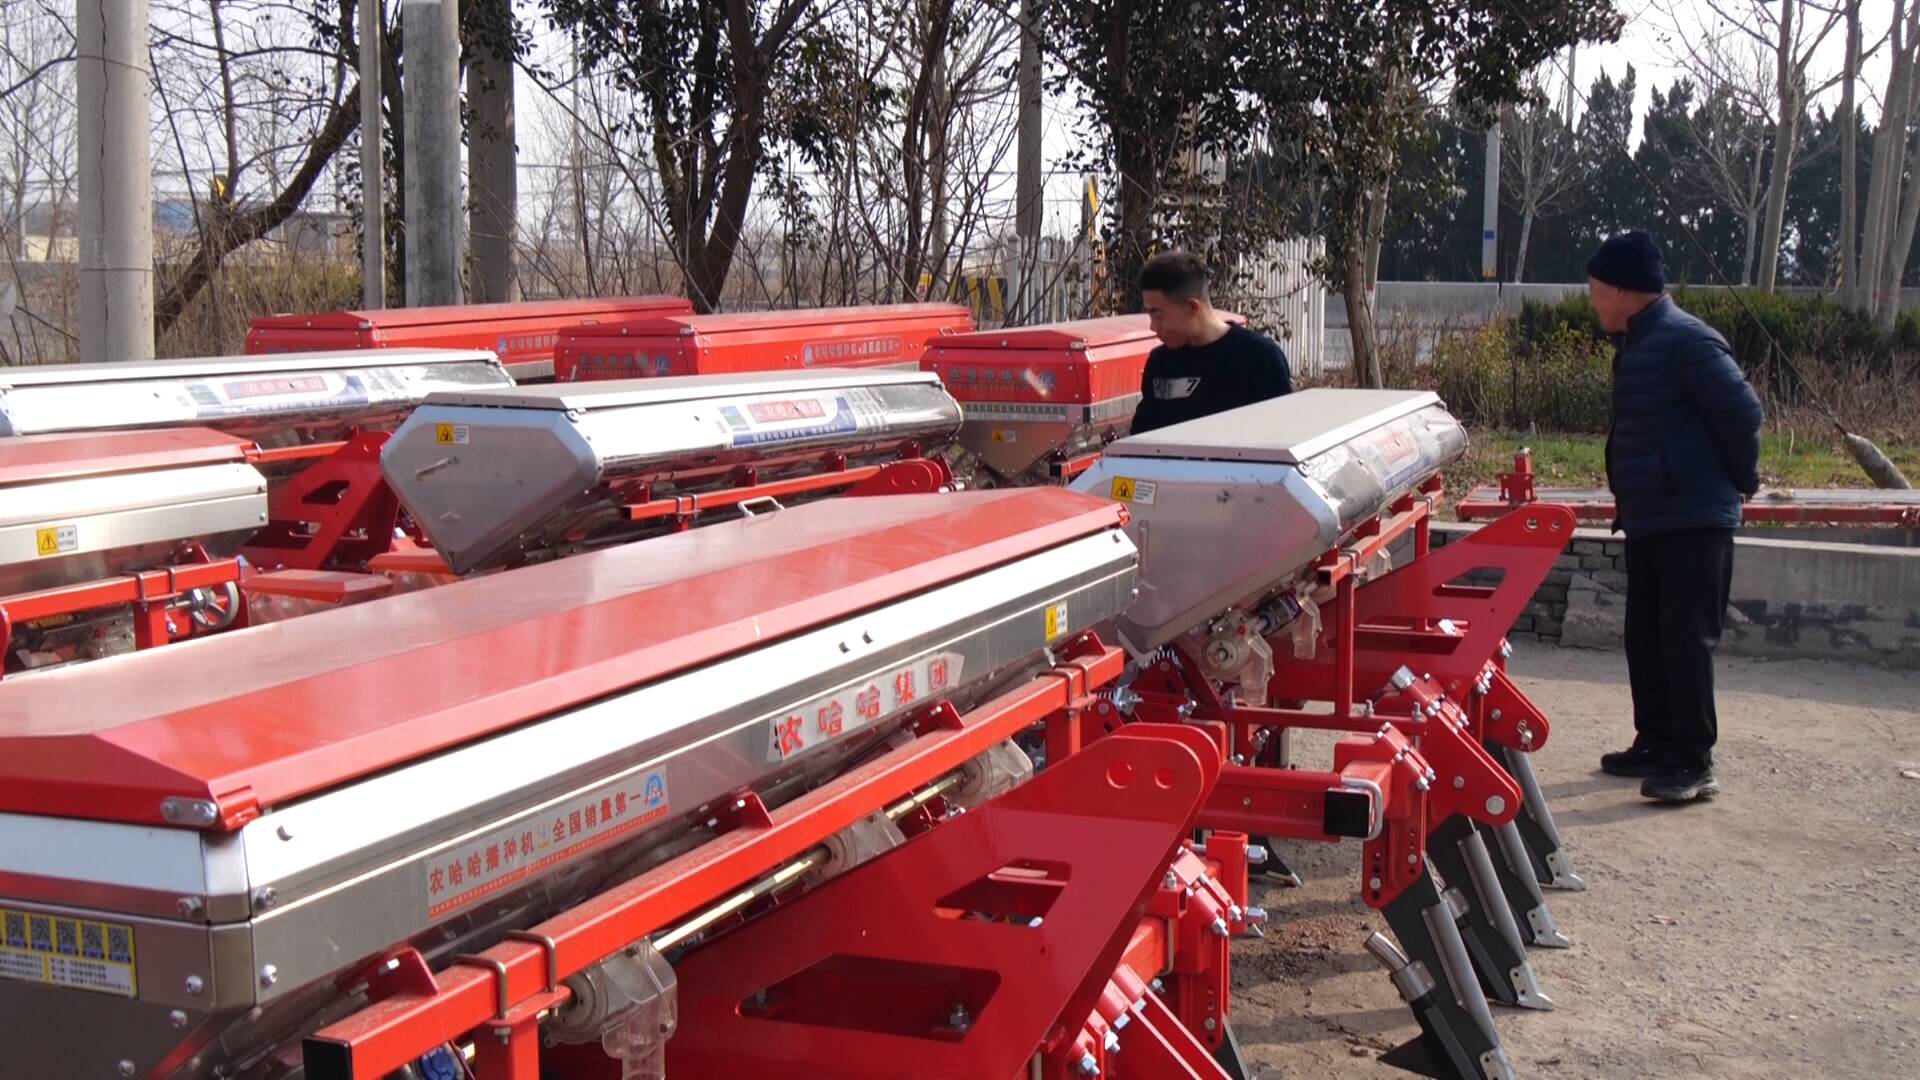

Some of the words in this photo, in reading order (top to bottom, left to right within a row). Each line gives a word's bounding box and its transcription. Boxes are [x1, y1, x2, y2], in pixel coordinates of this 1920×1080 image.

[778, 656, 948, 755] 农哈哈集团
[429, 831, 535, 895] 农哈哈播种机
[552, 791, 641, 843] 全国销量第一
